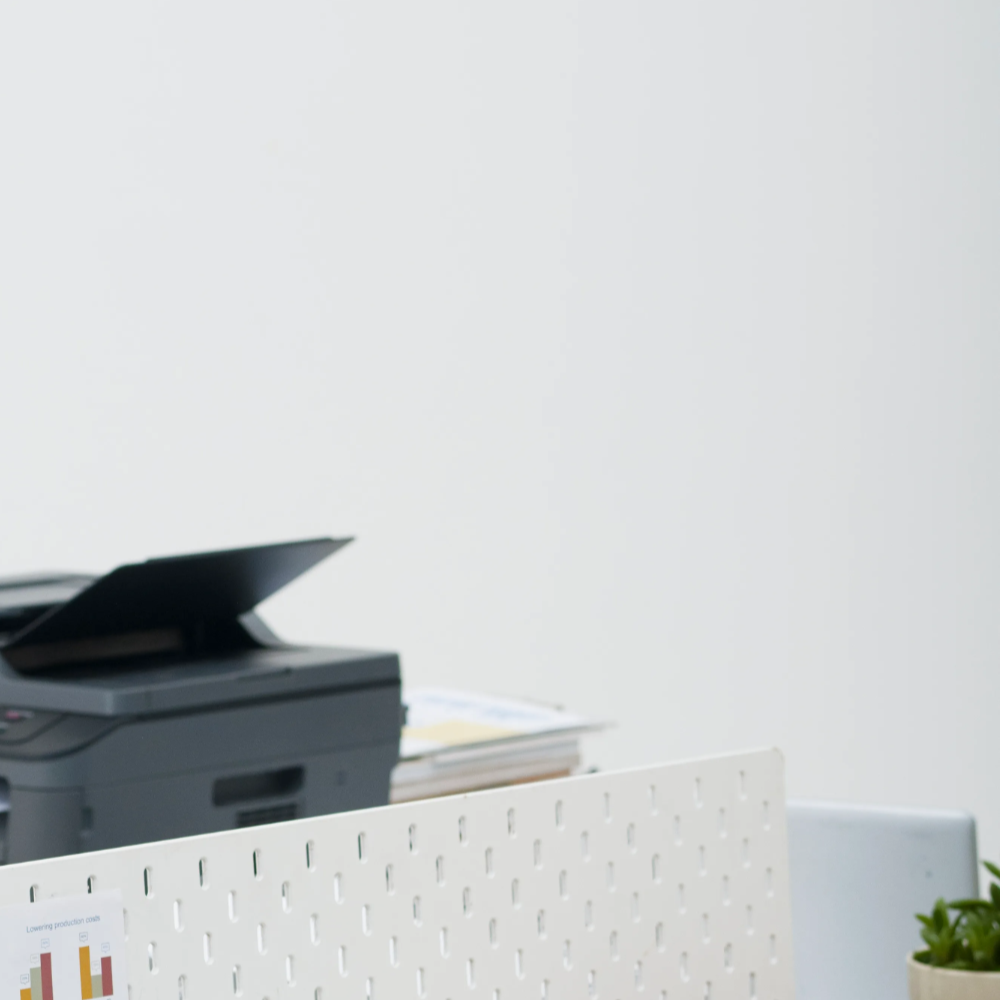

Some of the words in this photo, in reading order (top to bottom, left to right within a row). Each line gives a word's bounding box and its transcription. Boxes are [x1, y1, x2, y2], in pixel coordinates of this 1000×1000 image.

[26, 922, 53, 934] Lowering
[54, 917, 85, 930] production
[85, 915, 101, 924] costs
